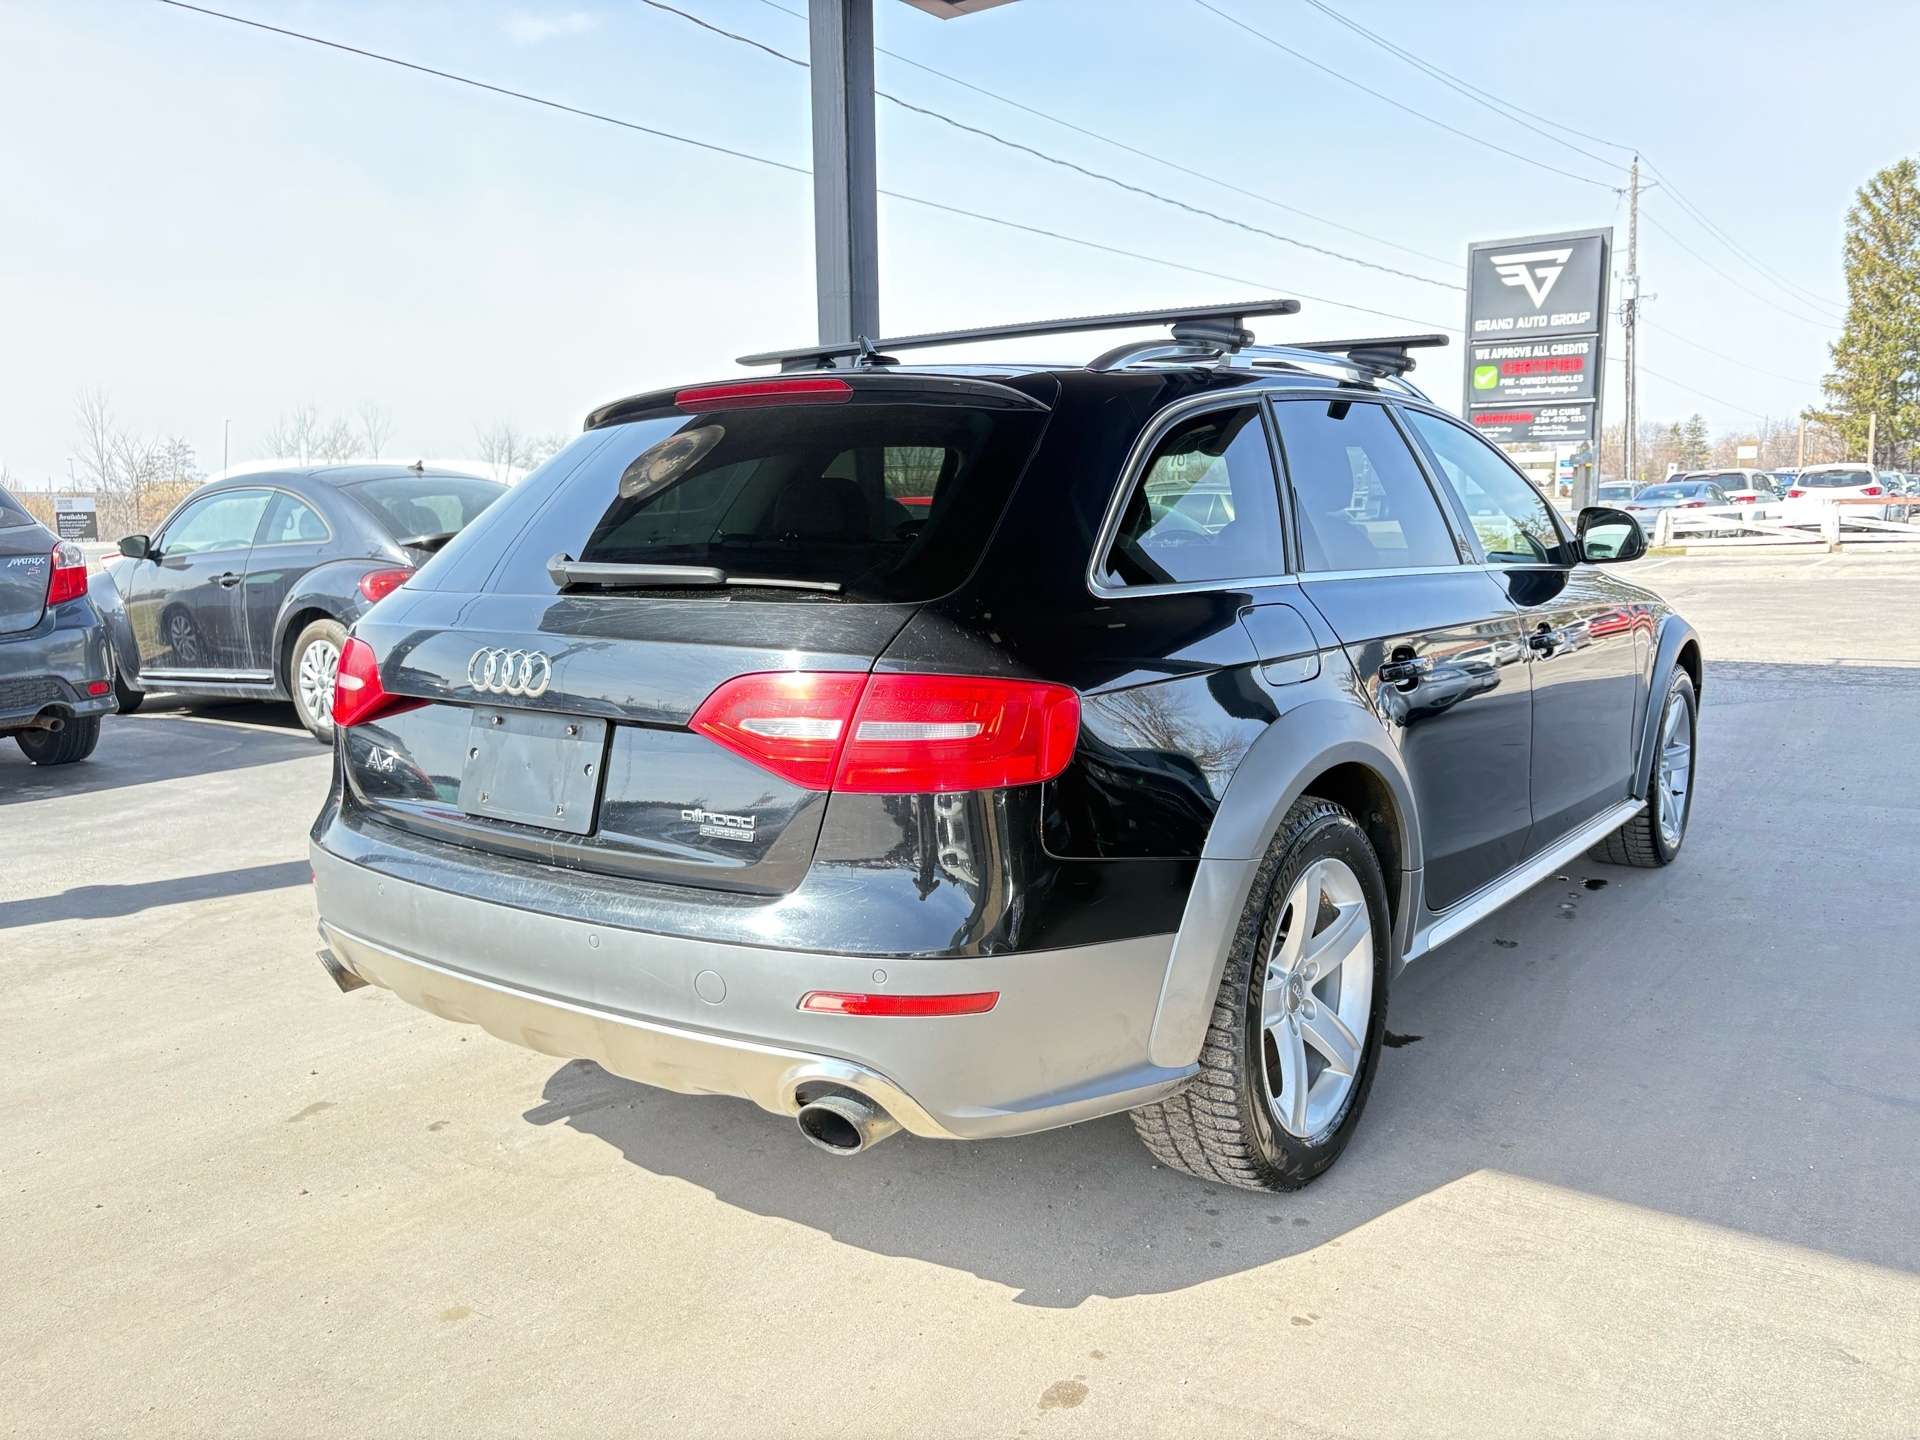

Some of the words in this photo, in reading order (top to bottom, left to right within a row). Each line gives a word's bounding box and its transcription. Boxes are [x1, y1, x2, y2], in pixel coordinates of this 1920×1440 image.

[1475, 319, 1513, 331] GRAND
[1517, 316, 1547, 328] AUTO
[1551, 312, 1590, 325] GROUP
[1475, 349, 1490, 359] WE
[1491, 346, 1532, 359] APPROVE
[1532, 345, 1549, 356] ALL
[1551, 343, 1589, 354] CREDITS
[1548, 375, 1584, 384] VEHICLES
[1541, 408, 1557, 417] CAR
[7, 557, 45, 568] MATRIX
[365, 746, 394, 773] A4
[681, 808, 756, 829] allroad
